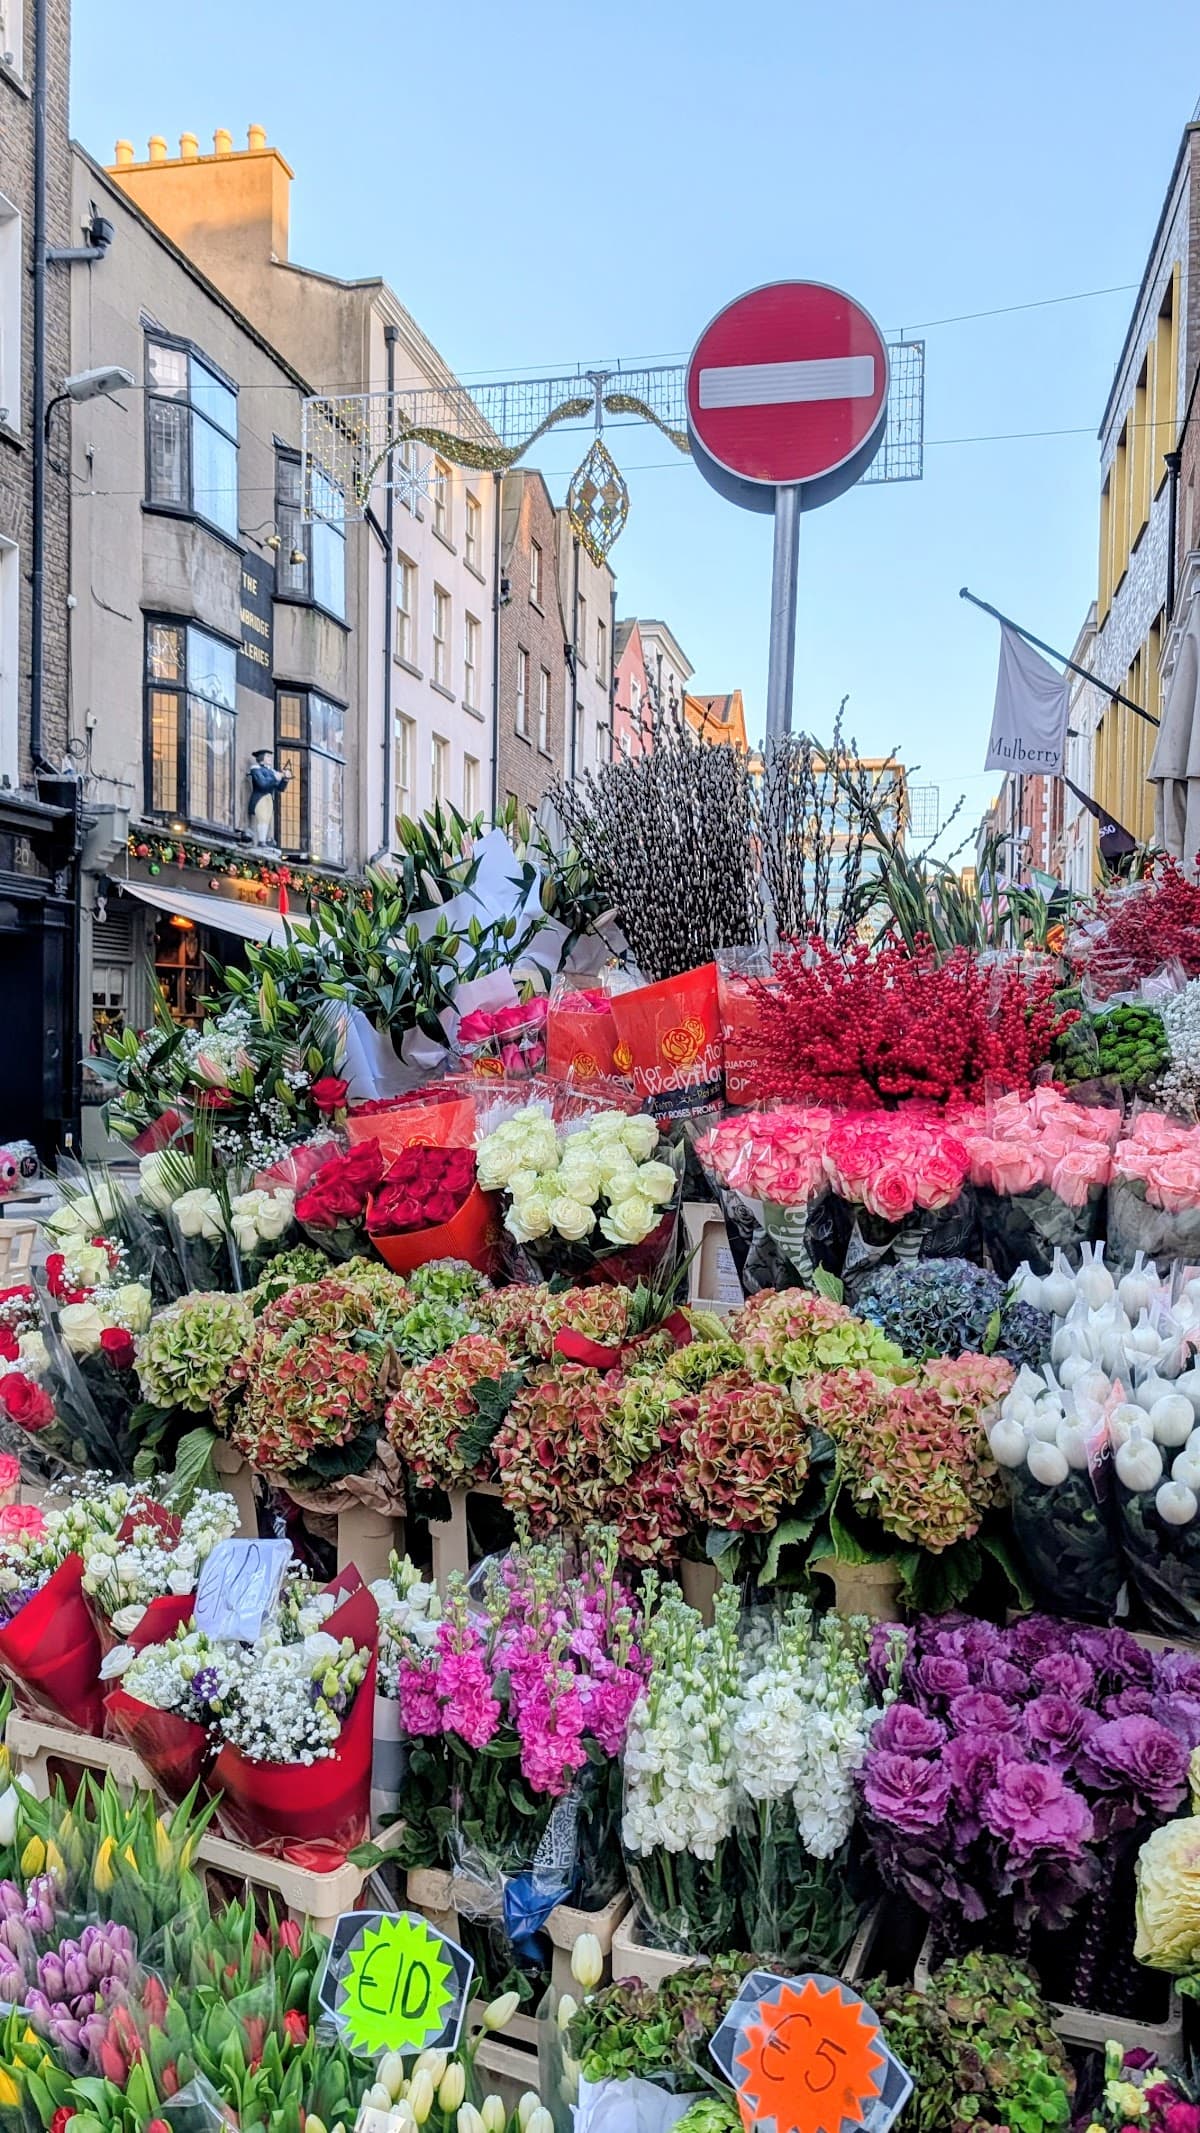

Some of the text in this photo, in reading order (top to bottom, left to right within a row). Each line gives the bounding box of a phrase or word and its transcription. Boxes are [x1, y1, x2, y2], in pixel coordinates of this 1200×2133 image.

[242, 571, 258, 596] THE
[990, 737, 1061, 767] Mulberry
[15, 846, 29, 866] 20
[668, 1109, 691, 1120] ROSES
[692, 1103, 717, 1117] FROM
[358, 1942, 431, 2019] €10
[761, 2013, 847, 2092] €5
